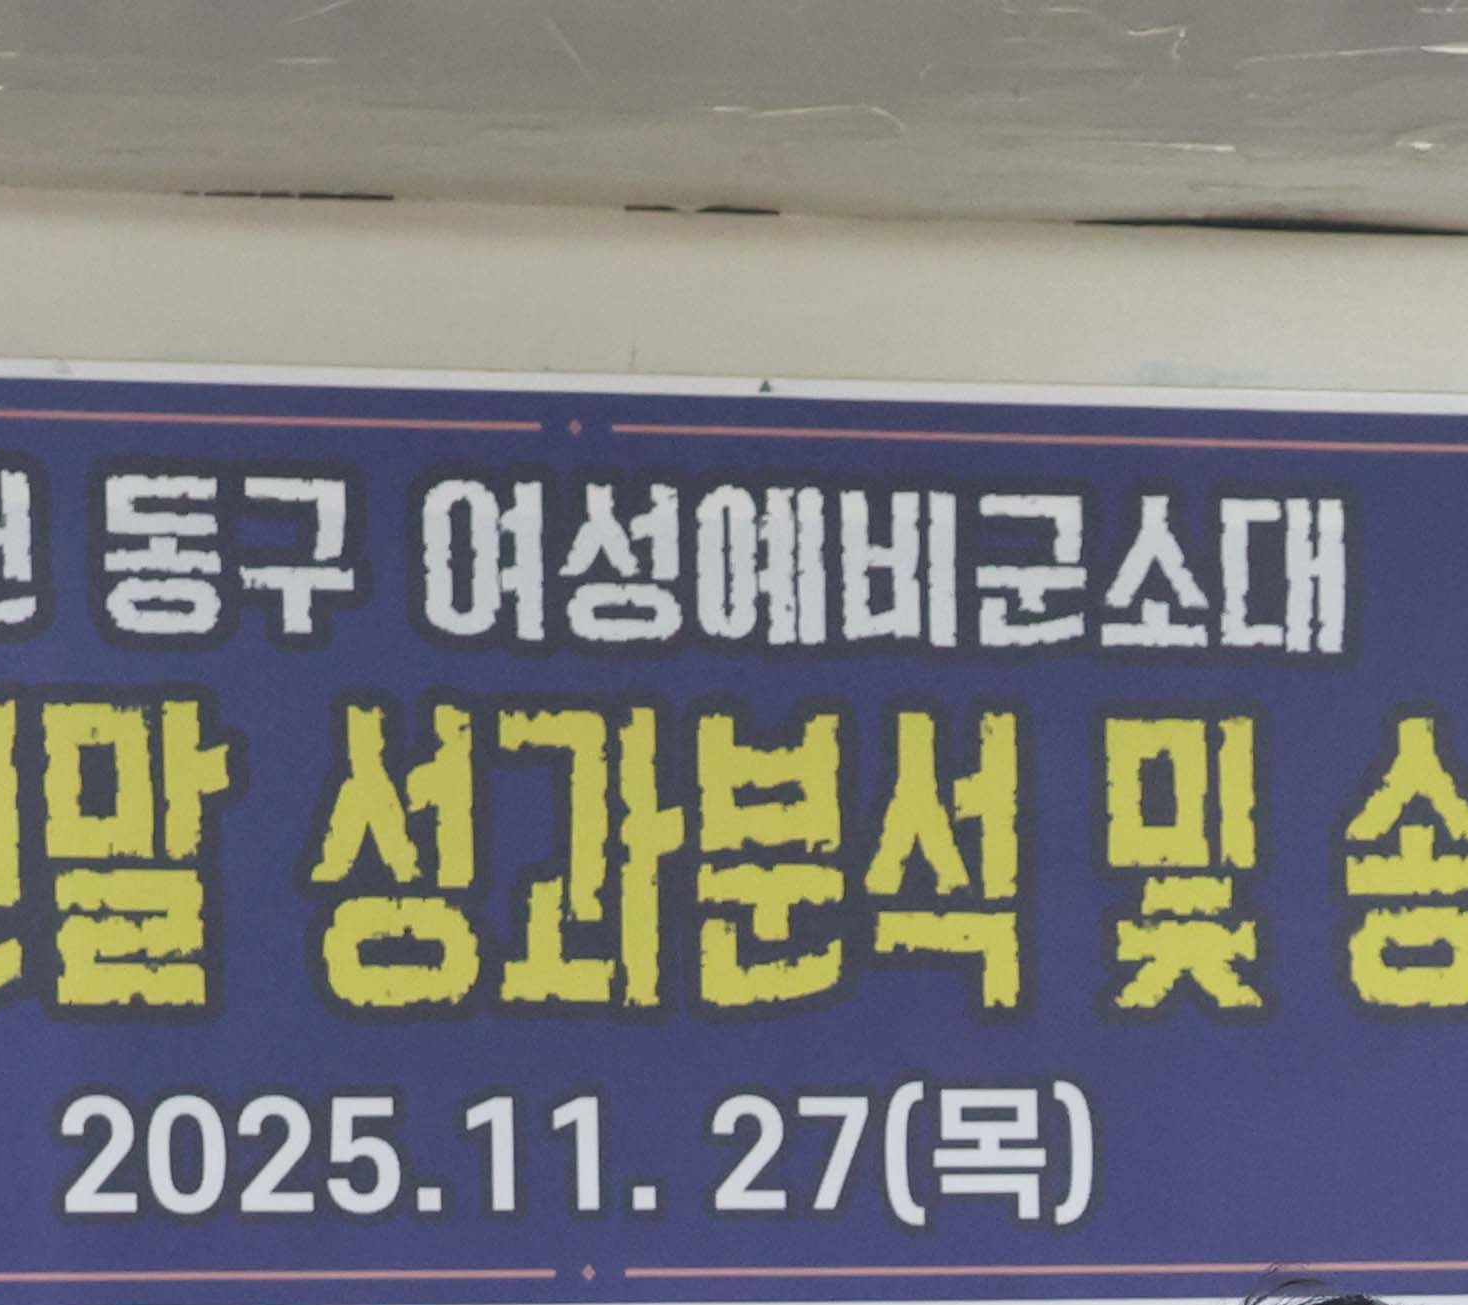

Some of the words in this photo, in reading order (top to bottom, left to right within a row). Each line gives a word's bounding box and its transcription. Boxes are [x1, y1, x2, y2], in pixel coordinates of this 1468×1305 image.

[102, 474, 355, 636] 동구
[421, 476, 1348, 654] 여성예비군소대
[308, 702, 1022, 1009] 성과분석
[1103, 716, 1264, 1009] 및
[59, 1093, 660, 1217] 2025.11.
[710, 1080, 1096, 1228] 27(목)
